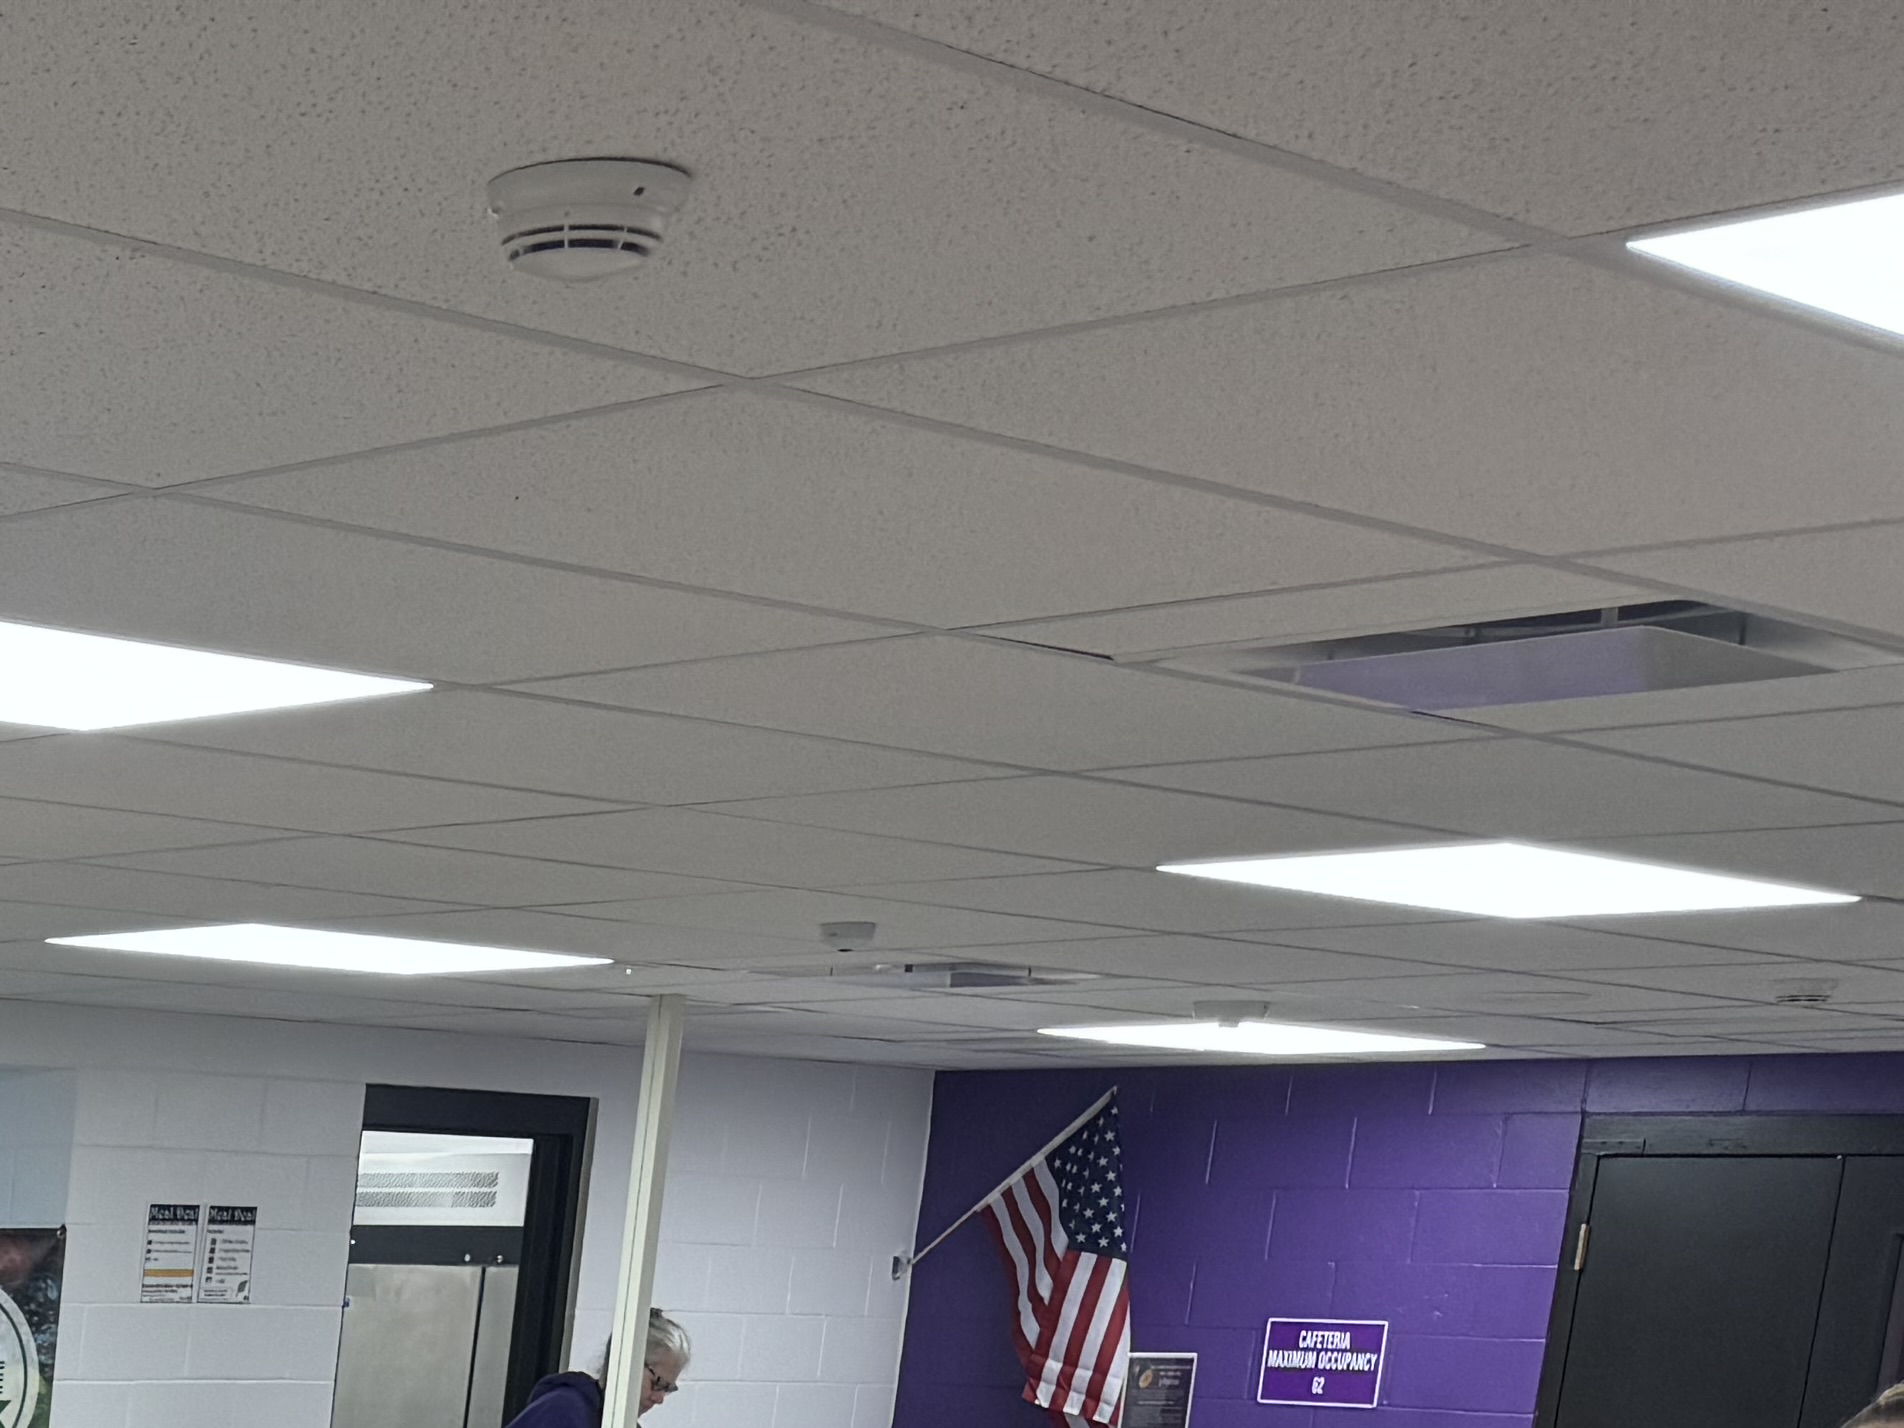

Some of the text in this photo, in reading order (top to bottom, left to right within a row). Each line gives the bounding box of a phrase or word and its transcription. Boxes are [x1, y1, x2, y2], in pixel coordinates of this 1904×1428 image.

[1298, 1329, 1352, 1349] CAFETERIA
[1266, 1349, 1378, 1372] MAXIMUM OCCUPANCY
[1311, 1376, 1325, 1395] 62
